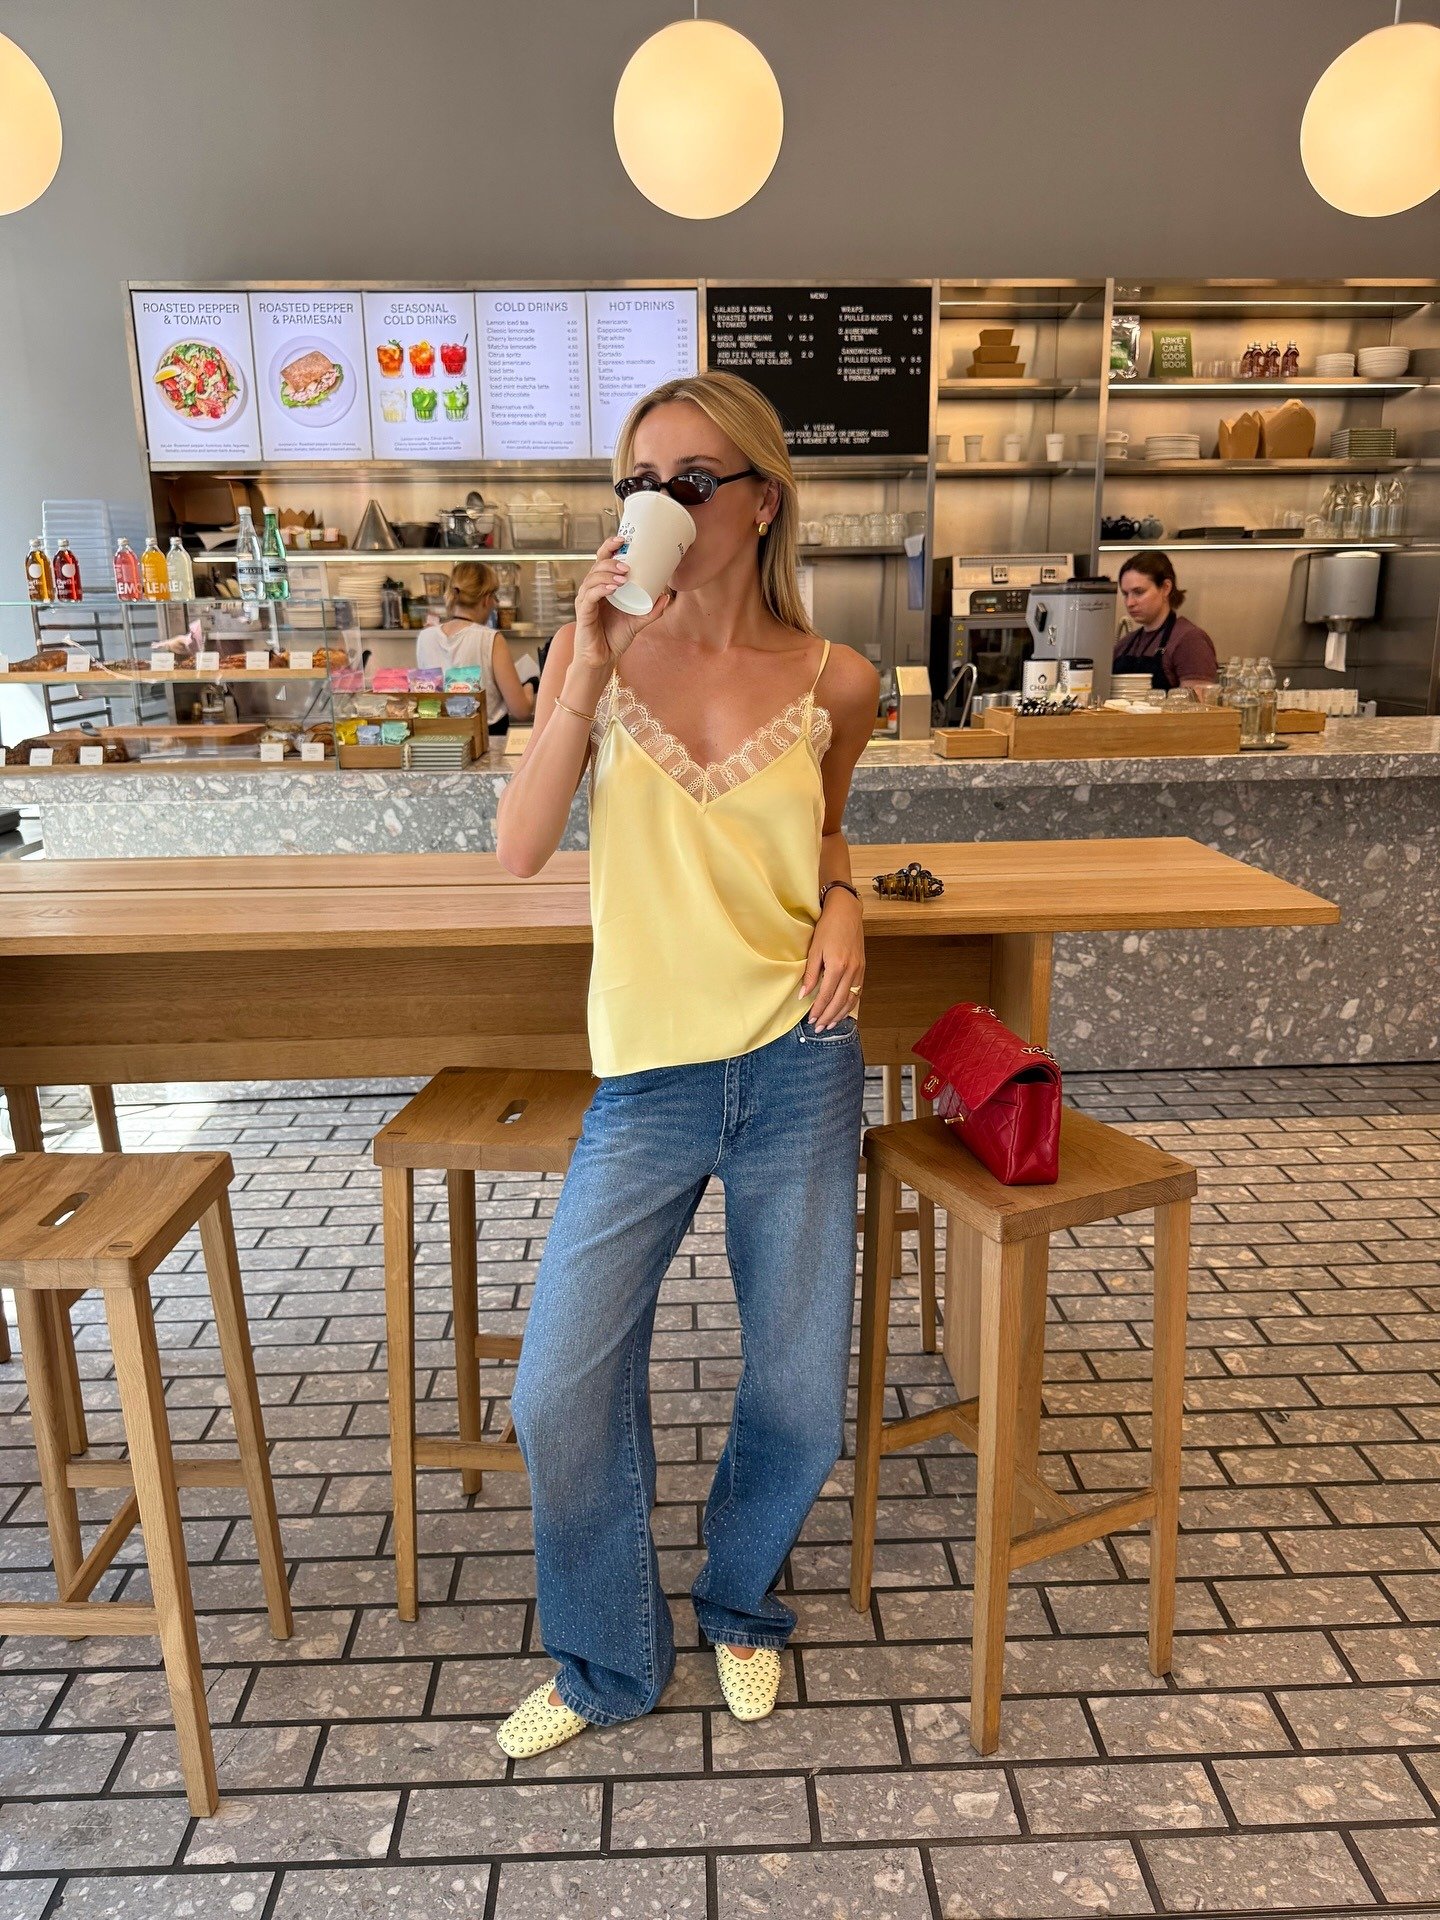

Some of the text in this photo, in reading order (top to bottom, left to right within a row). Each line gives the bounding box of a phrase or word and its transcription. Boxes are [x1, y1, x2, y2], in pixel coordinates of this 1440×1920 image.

[142, 303, 240, 314] ROASTED PEPPER
[259, 302, 354, 313] ROASTED PEPPER
[390, 304, 449, 314] SEASONAL
[494, 302, 569, 312] COLD DRINKS
[608, 301, 675, 311] HOT DRINKS
[164, 316, 222, 326] & TOMATO
[272, 315, 342, 325] & PARMESAN
[384, 315, 457, 325] COLD DRINKS
[748, 314, 774, 322] PEPPER
[871, 314, 893, 322] ROOTS
[1161, 353, 1187, 361] COOK
[1162, 361, 1187, 369] BOOK
